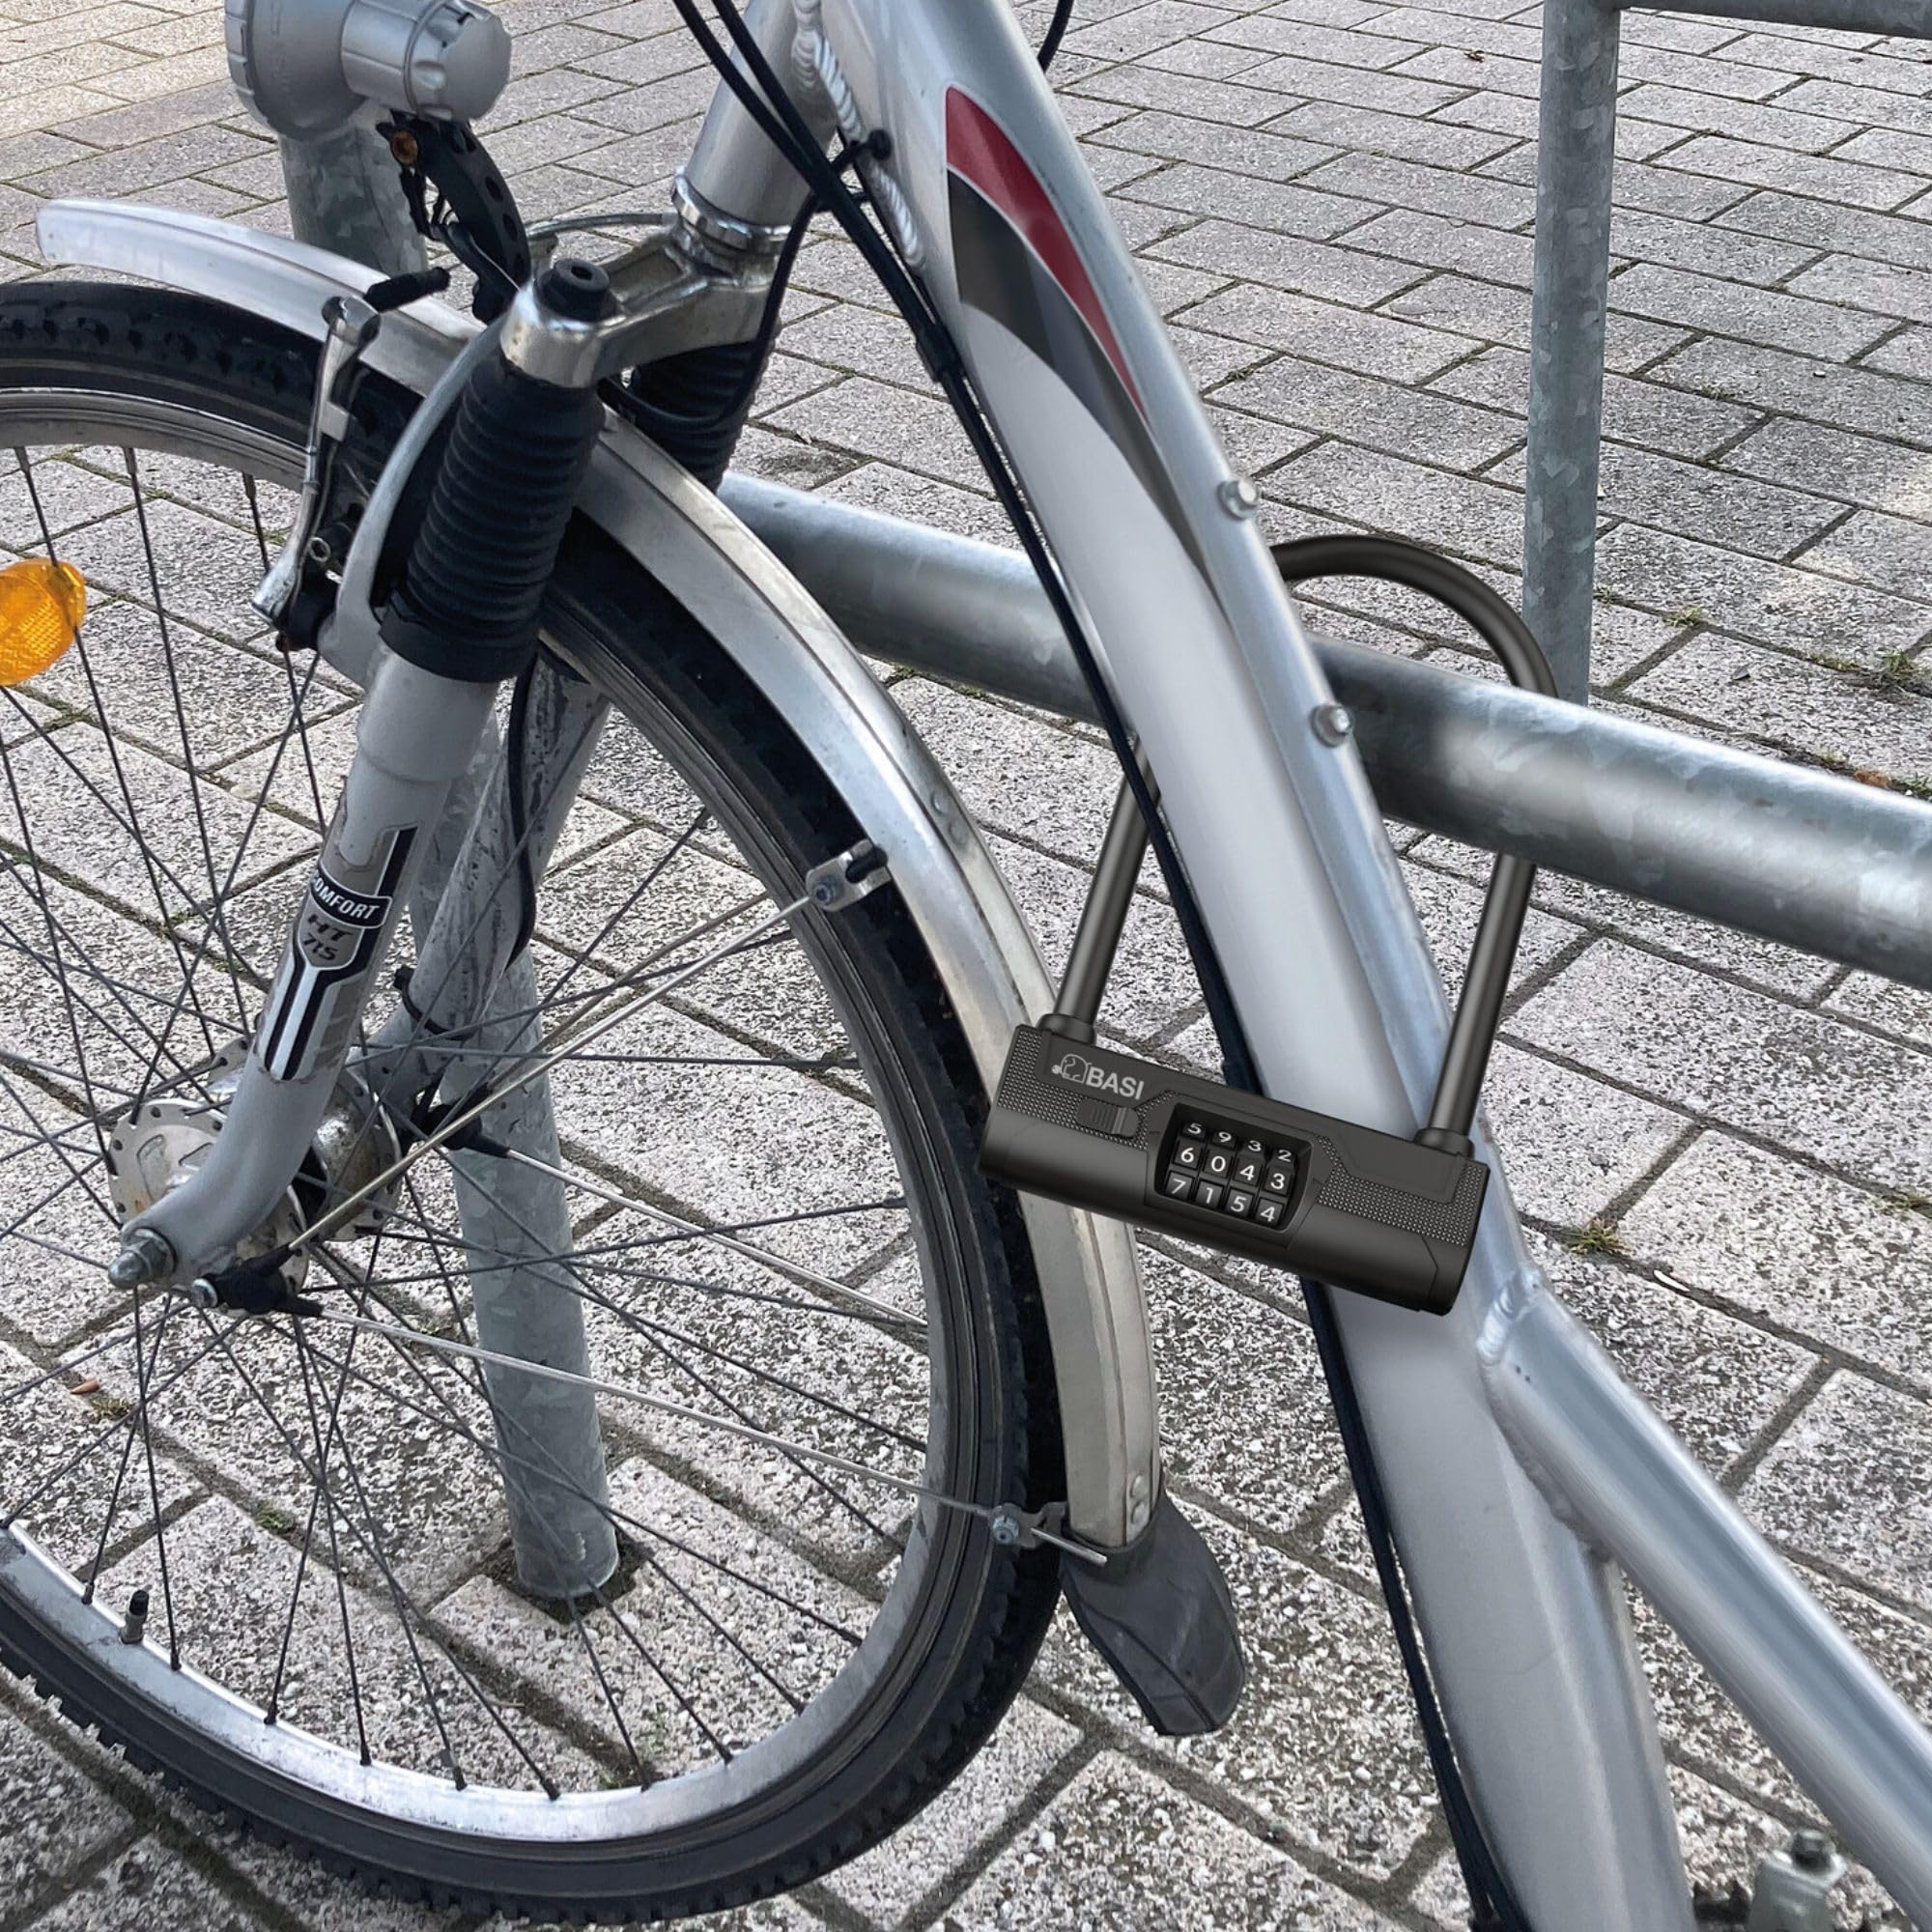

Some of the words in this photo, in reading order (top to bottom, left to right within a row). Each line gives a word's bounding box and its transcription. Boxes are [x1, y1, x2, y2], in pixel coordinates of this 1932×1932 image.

[308, 914, 354, 941] HT
[1086, 1065, 1145, 1100] BASI
[1187, 1122, 1203, 1135] 5
[1218, 1131, 1232, 1143] 9
[1247, 1140, 1262, 1151] 3
[1277, 1150, 1292, 1162] 2
[1180, 1147, 1194, 1163] 6
[1210, 1155, 1226, 1172] 0
[1239, 1165, 1255, 1180] 4
[1270, 1173, 1285, 1189] 3
[1171, 1178, 1186, 1194] 7
[1206, 1187, 1213, 1205] 1
[1230, 1196, 1247, 1212] 5
[1260, 1206, 1275, 1222] 4
